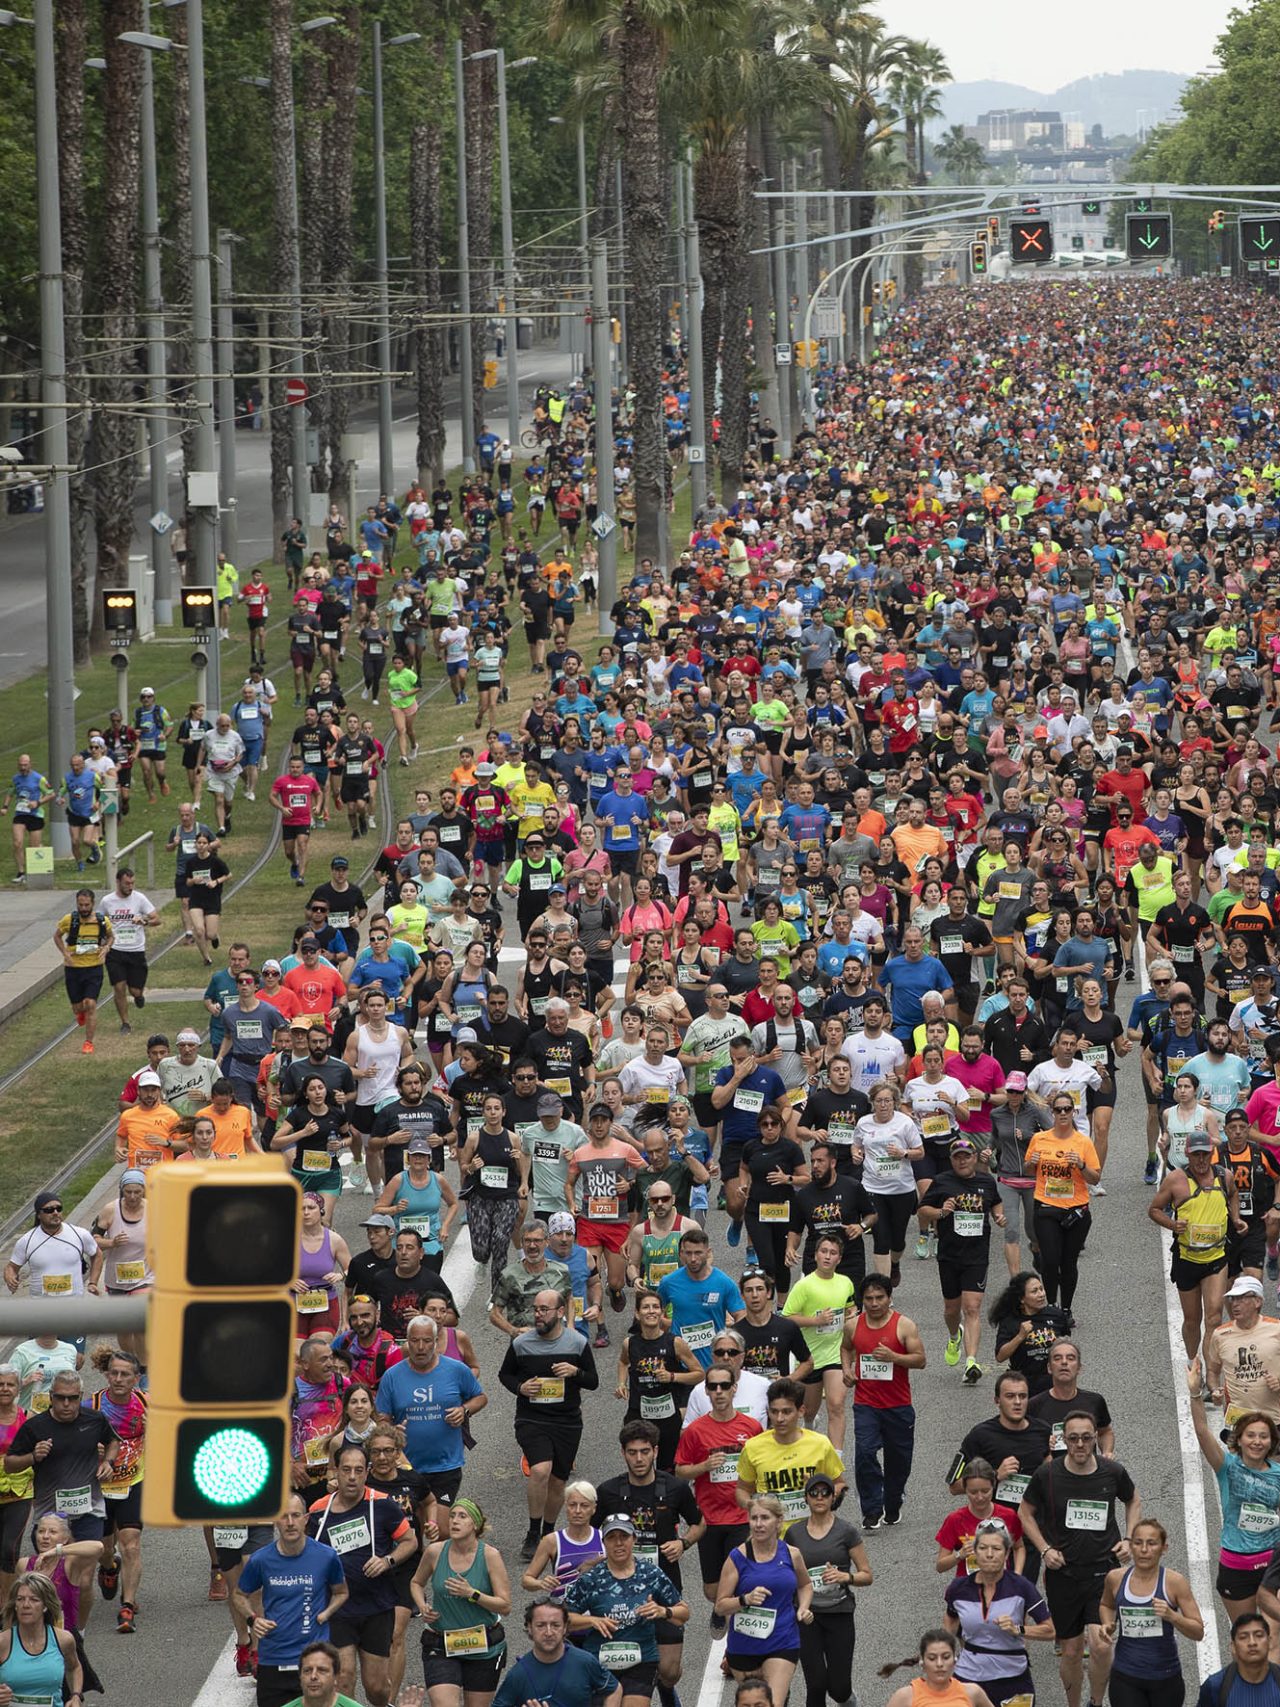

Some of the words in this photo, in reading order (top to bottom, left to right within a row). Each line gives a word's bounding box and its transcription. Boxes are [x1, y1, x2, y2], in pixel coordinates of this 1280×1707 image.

[537, 1149, 555, 1157] 3395
[587, 1171, 617, 1186] RUN
[589, 1185, 617, 1197] VNG
[595, 1205, 612, 1213] 1751
[766, 1207, 783, 1215] 5031
[688, 1333, 712, 1342] 22106
[865, 1365, 888, 1373] 11430
[644, 1404, 670, 1413] 18978
[61, 1498, 88, 1507] 26558
[1074, 1512, 1100, 1521] 13155
[1245, 1514, 1274, 1526] 29875
[218, 1532, 243, 1540] 20704
[336, 1531, 364, 1545] 12876
[740, 1618, 769, 1629] 26419
[1125, 1620, 1156, 1629] 25432
[605, 1654, 635, 1663] 26418
